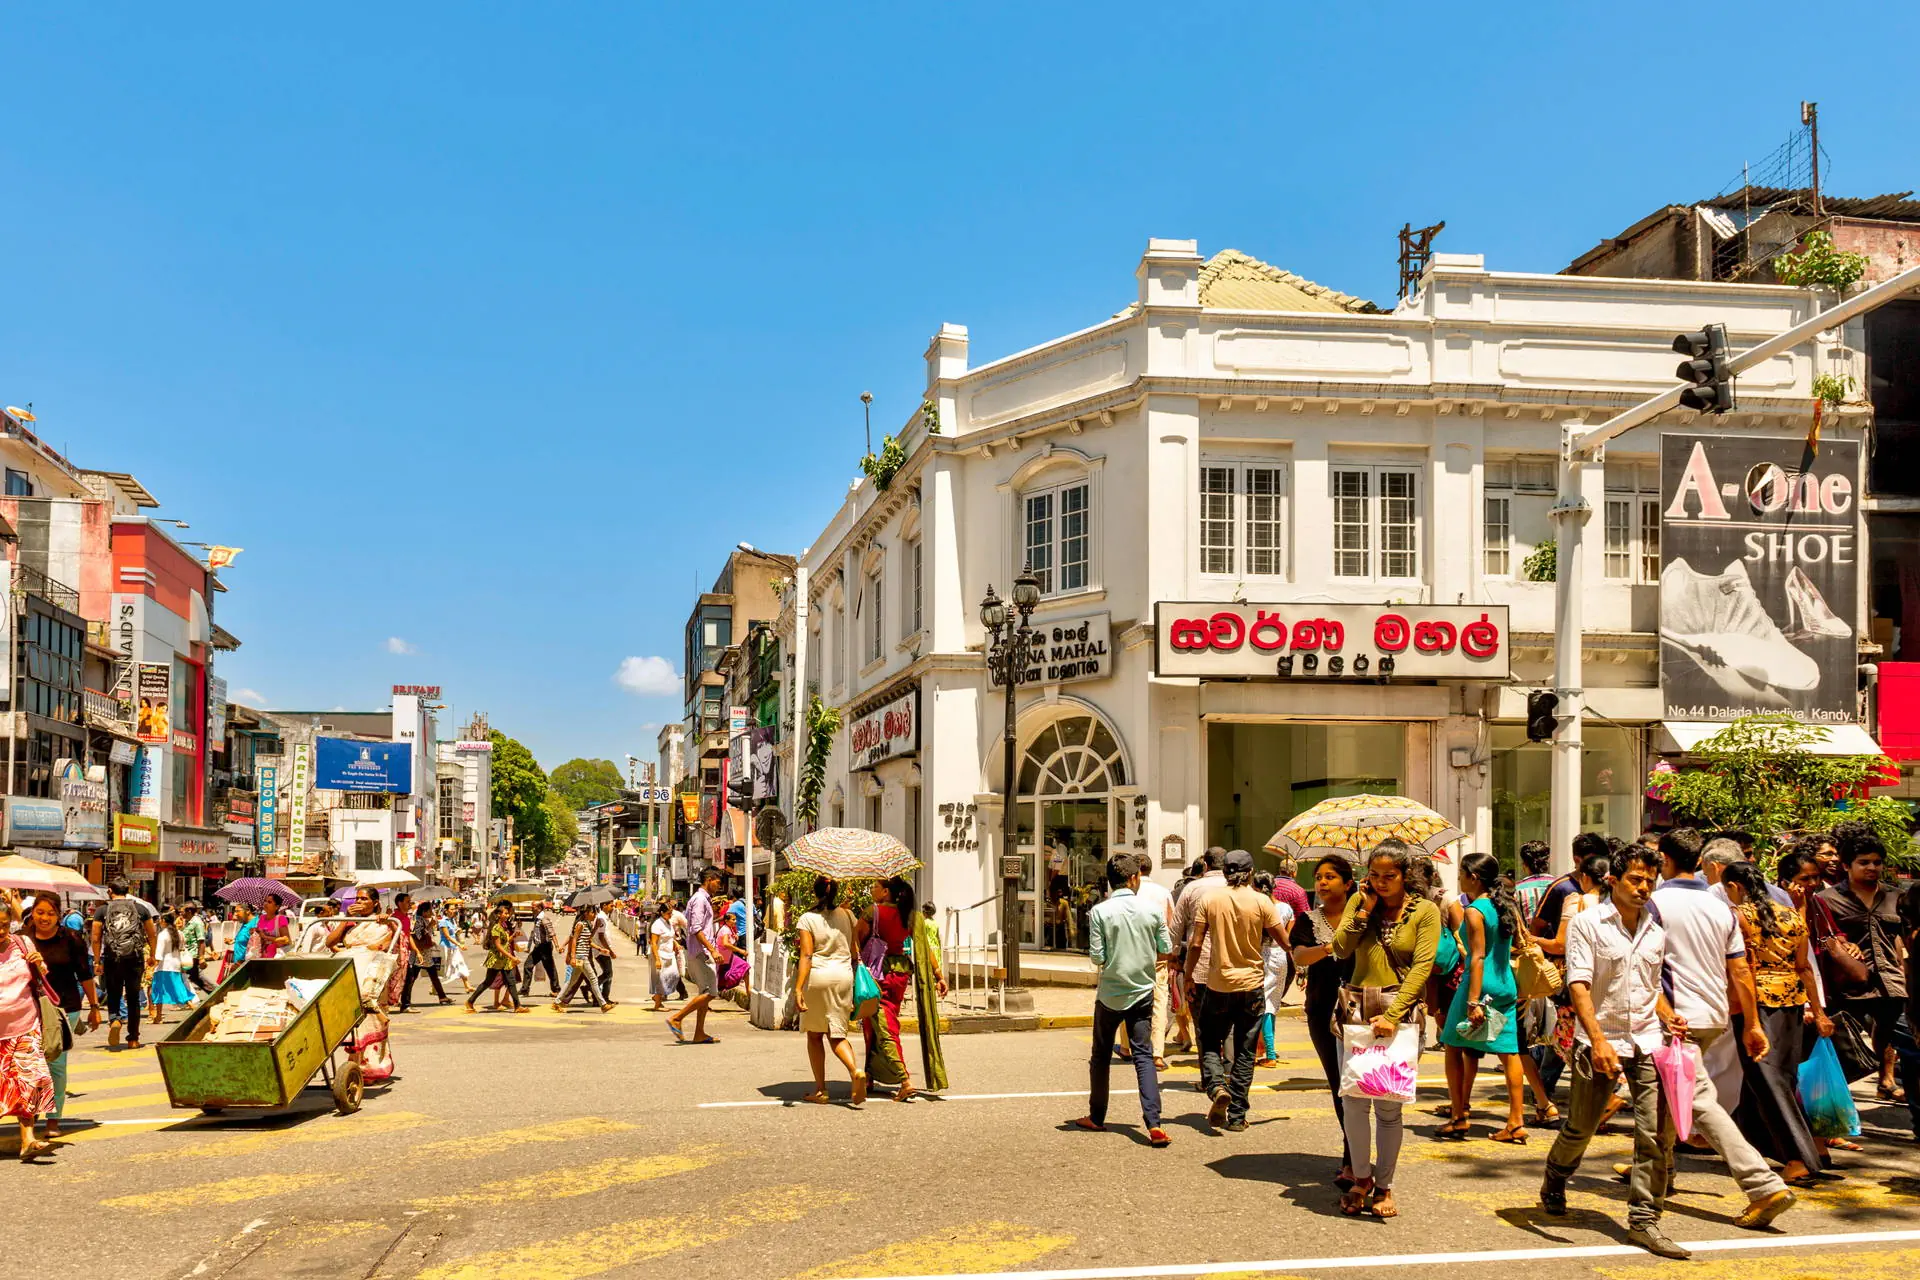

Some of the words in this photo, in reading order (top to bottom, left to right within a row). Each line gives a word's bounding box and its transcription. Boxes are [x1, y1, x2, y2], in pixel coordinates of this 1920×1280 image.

[1664, 441, 1852, 519] A-One
[1744, 531, 1853, 564] SHOE
[1050, 640, 1107, 663] MAHAL
[1708, 705, 1753, 719] Dalada
[1812, 708, 1853, 722] Kandy.
[295, 745, 307, 789] SAREE
[291, 799, 304, 862] KINGDOM
